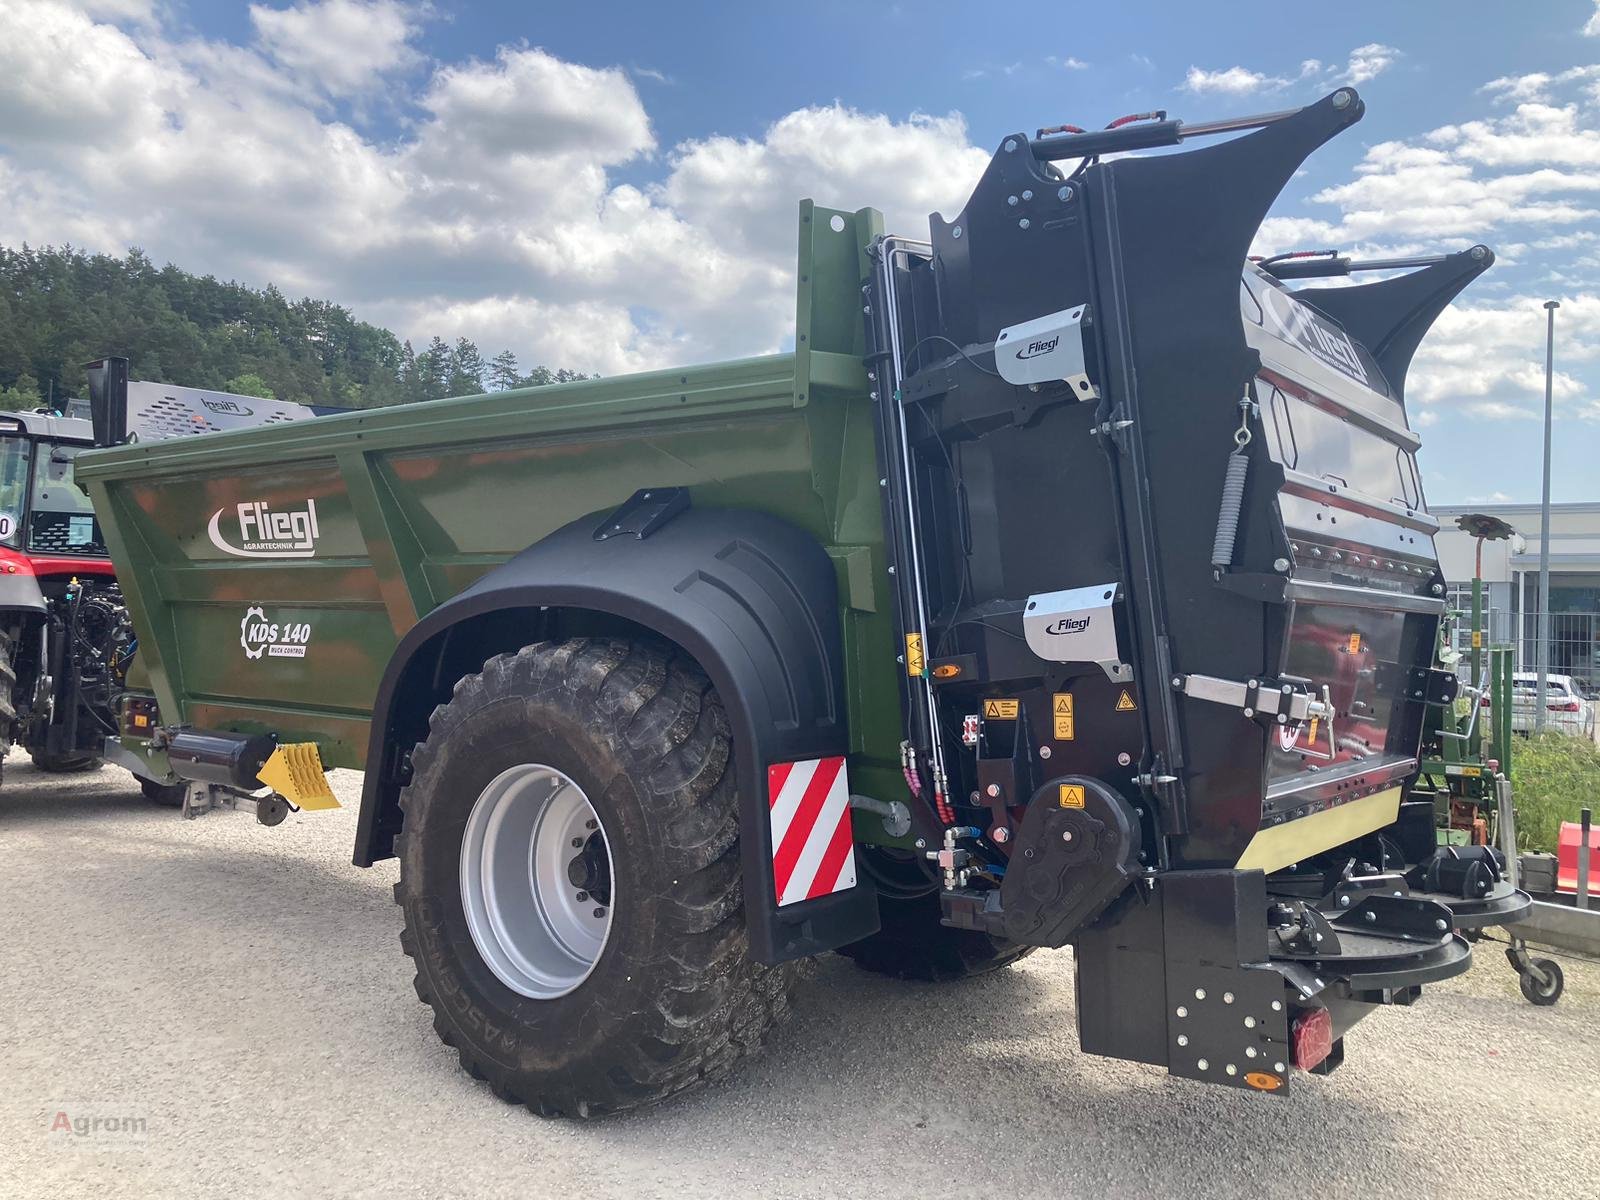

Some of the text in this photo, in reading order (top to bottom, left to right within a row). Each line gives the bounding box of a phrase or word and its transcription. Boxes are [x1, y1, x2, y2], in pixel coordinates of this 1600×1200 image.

[1028, 335, 1060, 354] Fliegl
[237, 499, 320, 549] Fliegl
[243, 542, 294, 550] AGRARTECHNIK
[1058, 615, 1091, 631] Fliegl
[248, 623, 311, 643] KDS 140
